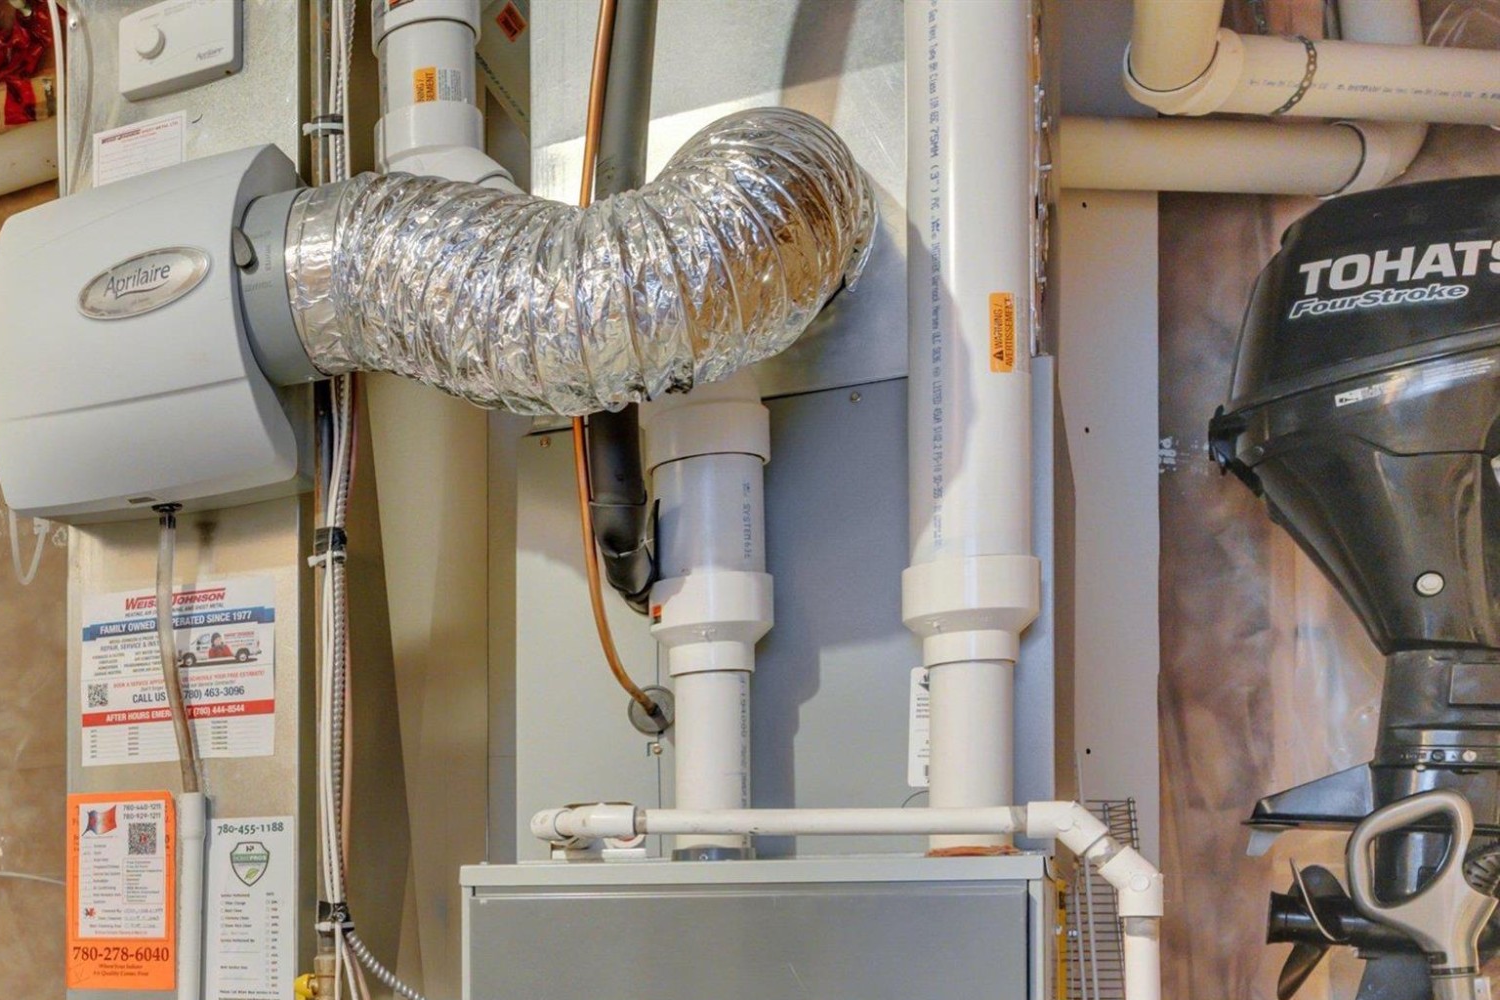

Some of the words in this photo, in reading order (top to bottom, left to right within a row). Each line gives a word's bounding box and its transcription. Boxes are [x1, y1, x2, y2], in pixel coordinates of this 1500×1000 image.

[930, 126, 940, 158] 75MM
[103, 262, 171, 298] Aprilaire
[1288, 283, 1469, 319] FourStroke
[993, 309, 1003, 350] WARNING
[1004, 298, 1014, 367] AVERTISSEMENT
[743, 503, 751, 541] SYSTEM
[100, 624, 127, 635] FAMILY
[128, 620, 156, 632] OWNED
[172, 614, 205, 627] PERATED
[206, 612, 231, 624] SINCE
[232, 610, 252, 620] 1977
[120, 642, 142, 651] SERVICE
[132, 693, 153, 704] CALL
[154, 691, 167, 702] US
[183, 688, 203, 700] 780)
[204, 686, 246, 698] 463-3096
[105, 713, 127, 723] AFTER
[127, 711, 150, 721] HOURS
[217, 821, 285, 836] 780-455-1188
[73, 945, 170, 963] 780-278-6040
